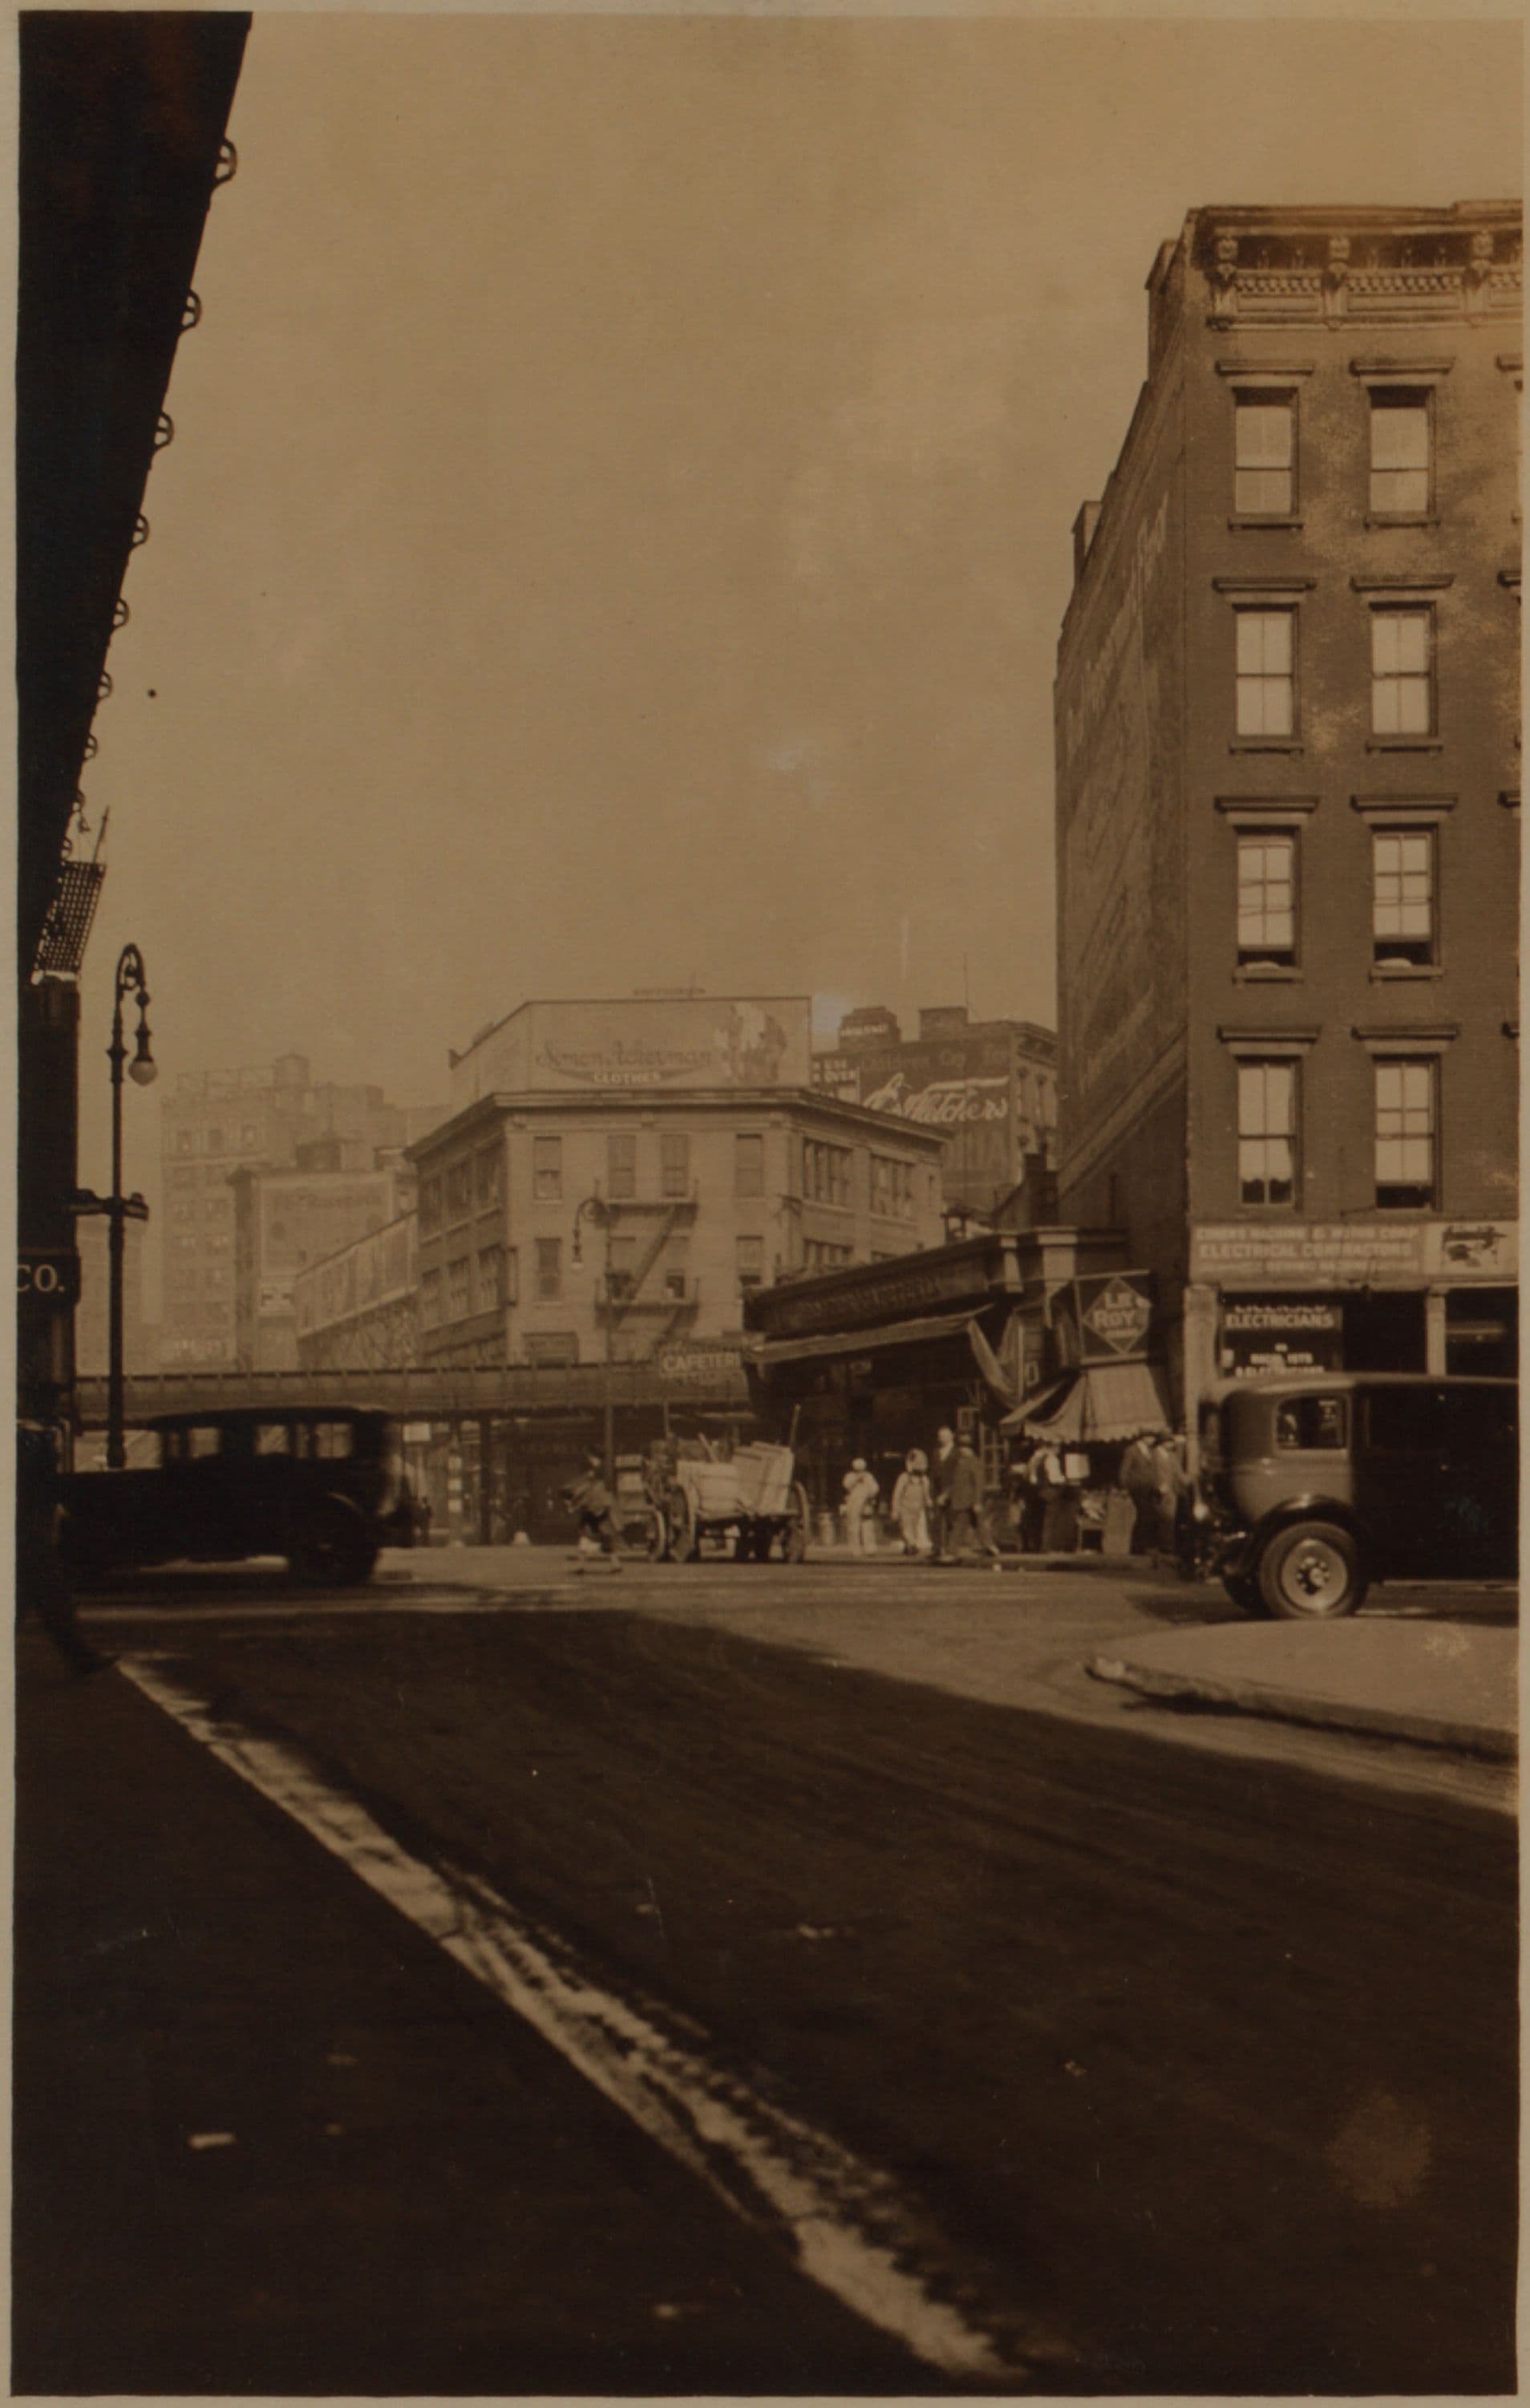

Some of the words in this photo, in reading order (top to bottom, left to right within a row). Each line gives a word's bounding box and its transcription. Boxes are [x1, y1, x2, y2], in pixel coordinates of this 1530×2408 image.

[1199, 1244, 1297, 1259] ELECTRICAL
[18, 1264, 65, 1292] CO.
[1092, 1309, 1137, 1329] ROY
[1224, 1313, 1335, 1329] ELECTRICIANS
[662, 1352, 741, 1372] CAFETERI
